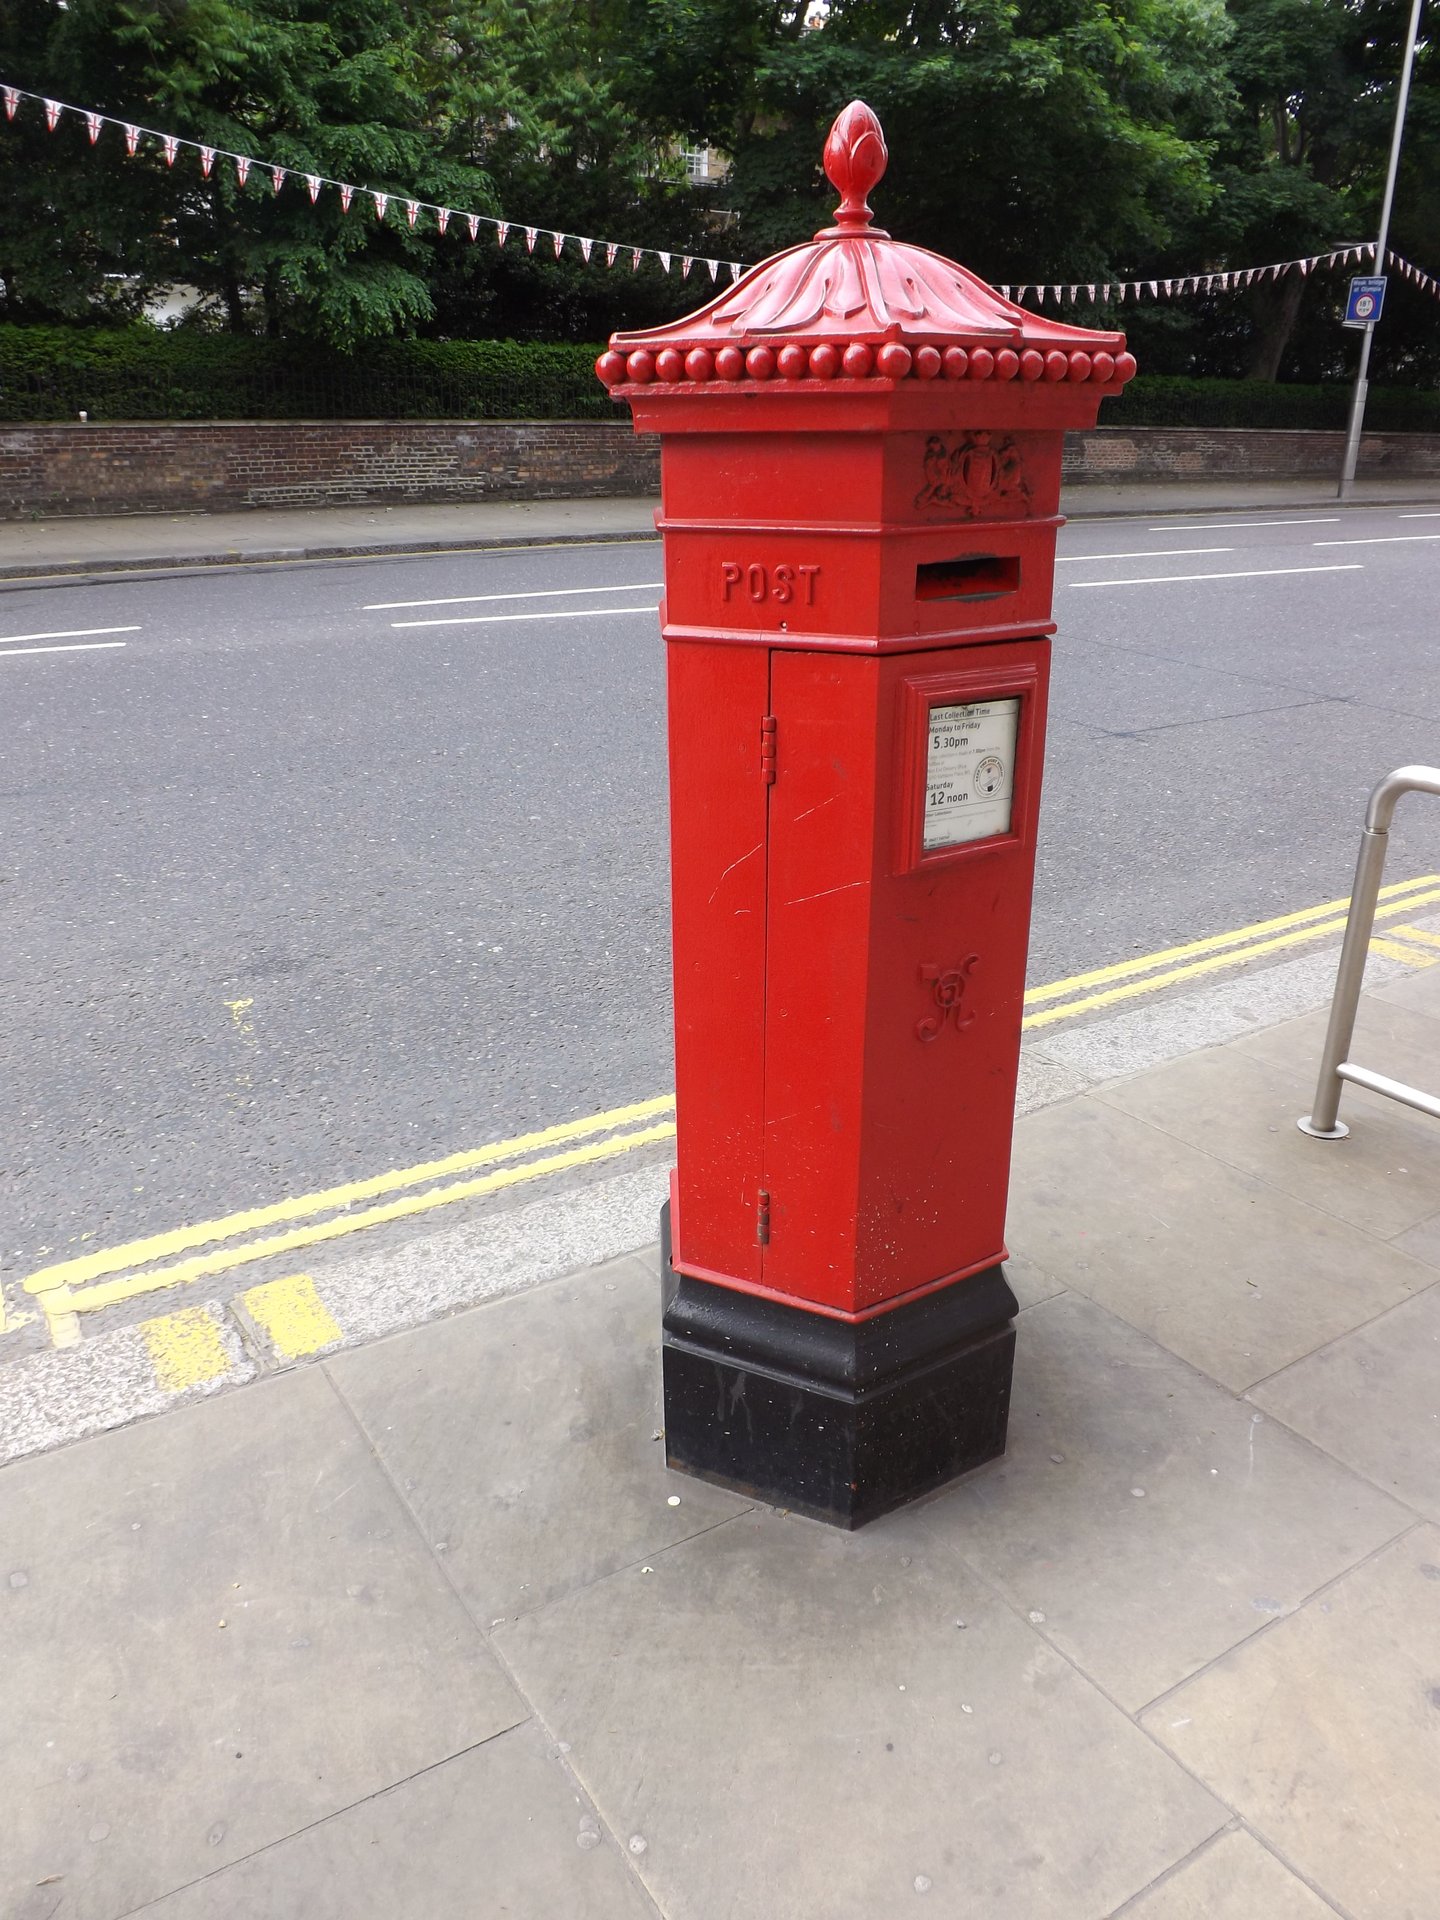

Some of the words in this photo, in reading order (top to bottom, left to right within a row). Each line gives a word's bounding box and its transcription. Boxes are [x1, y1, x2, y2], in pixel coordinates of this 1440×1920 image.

[721, 561, 820, 606] POST
[929, 713, 943, 722] Last
[944, 710, 974, 720] Collection
[975, 708, 990, 716] Time
[929, 724, 953, 734] Monday
[961, 722, 981, 730] Friday
[933, 735, 969, 750] 5.30pm
[926, 781, 954, 792] Saturday
[930, 791, 945, 806] 12
[946, 792, 969, 803] noon
